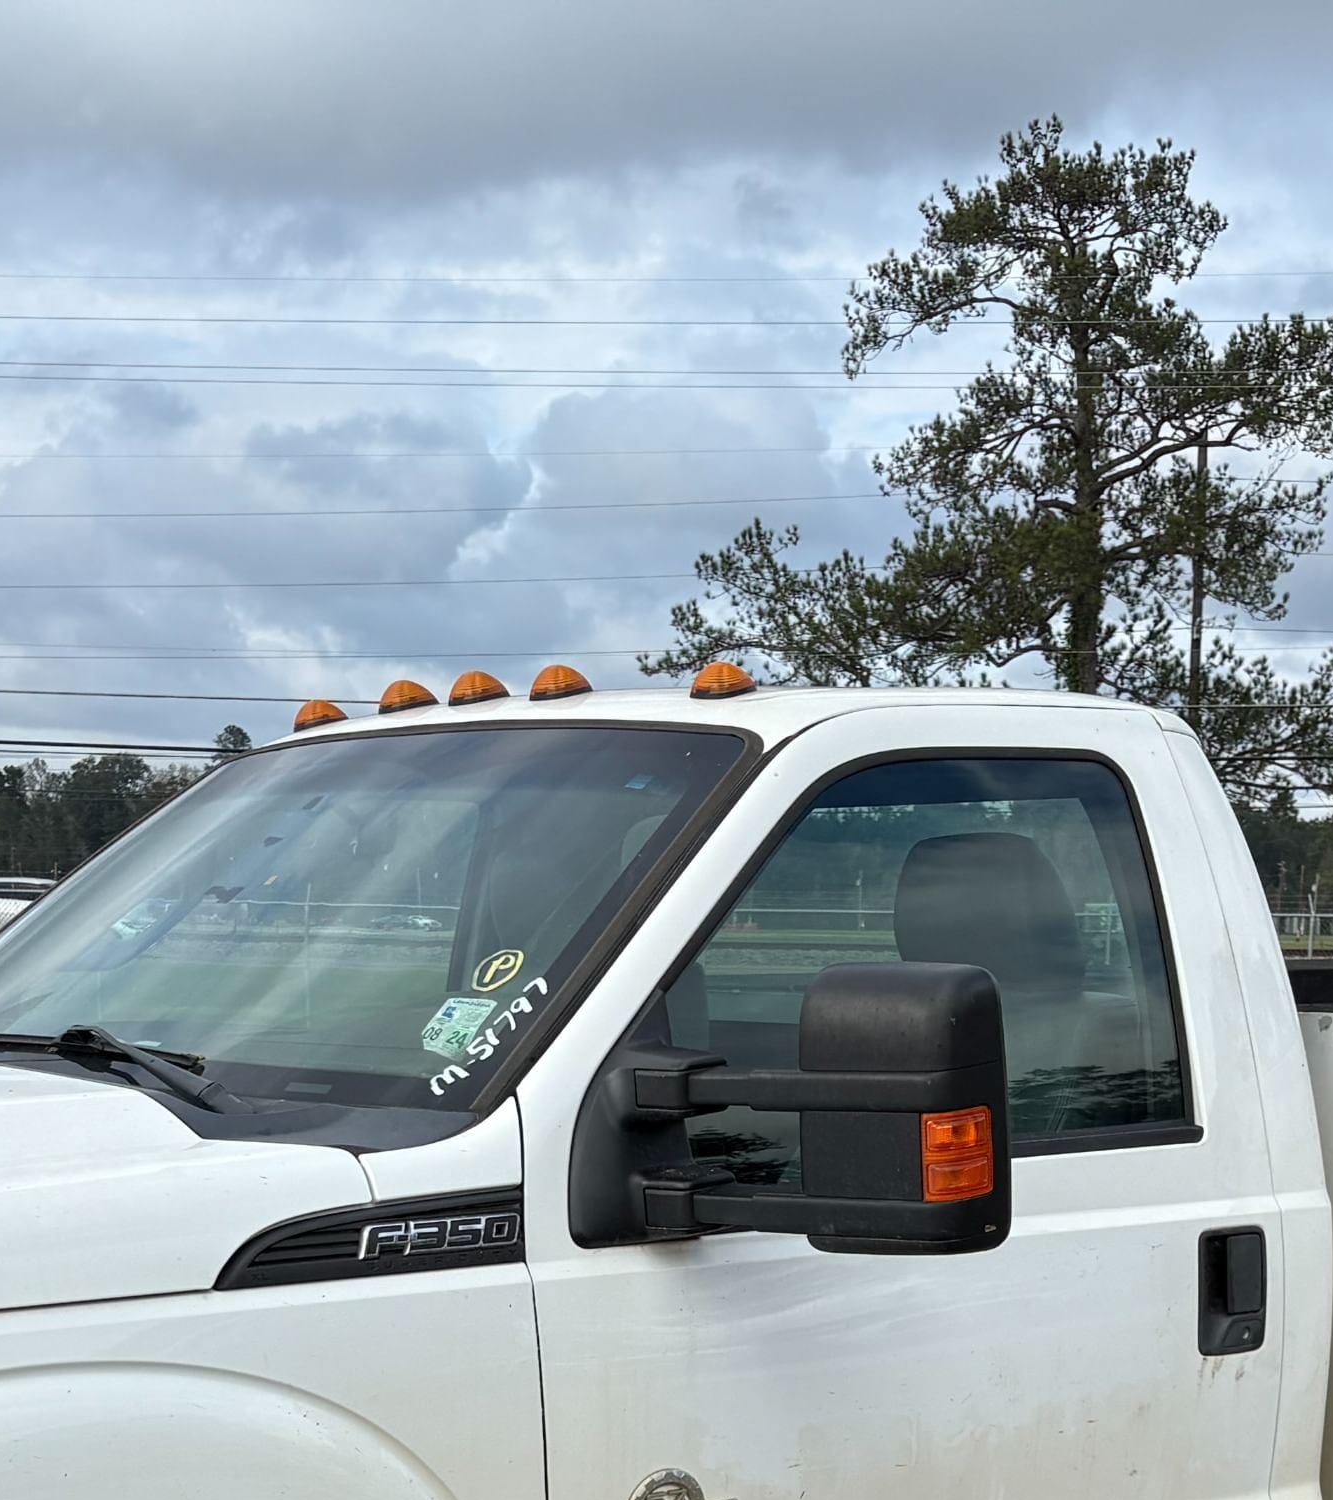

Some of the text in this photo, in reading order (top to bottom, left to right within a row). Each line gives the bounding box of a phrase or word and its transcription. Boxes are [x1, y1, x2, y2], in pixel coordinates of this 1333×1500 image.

[422, 1026, 469, 1049] 08 24
[357, 1212, 521, 1261] F-350
